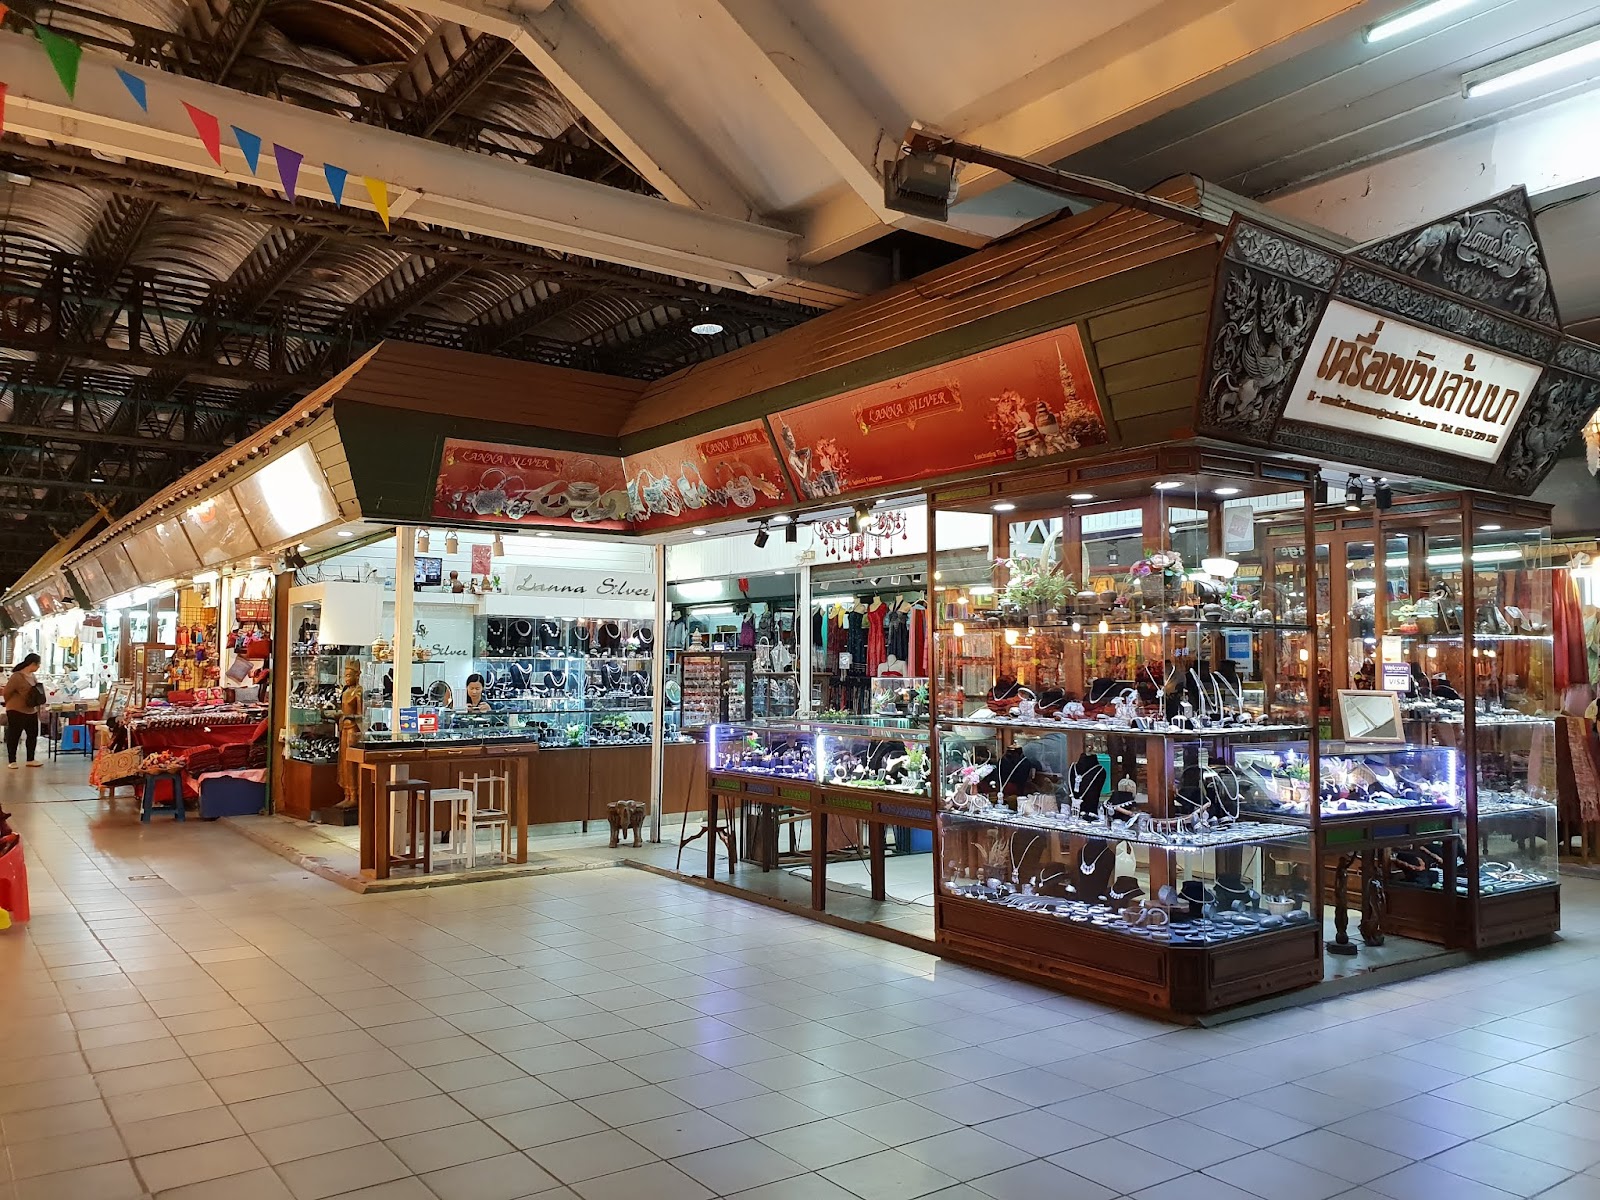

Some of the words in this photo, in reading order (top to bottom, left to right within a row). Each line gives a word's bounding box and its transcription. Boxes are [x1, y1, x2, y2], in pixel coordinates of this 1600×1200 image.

[868, 403, 904, 422] LANNA
[904, 391, 950, 415] SILVER
[462, 450, 503, 464] LANNA
[503, 456, 550, 470] SILVER
[516, 573, 588, 594] Lanna
[431, 643, 468, 656] Silver
